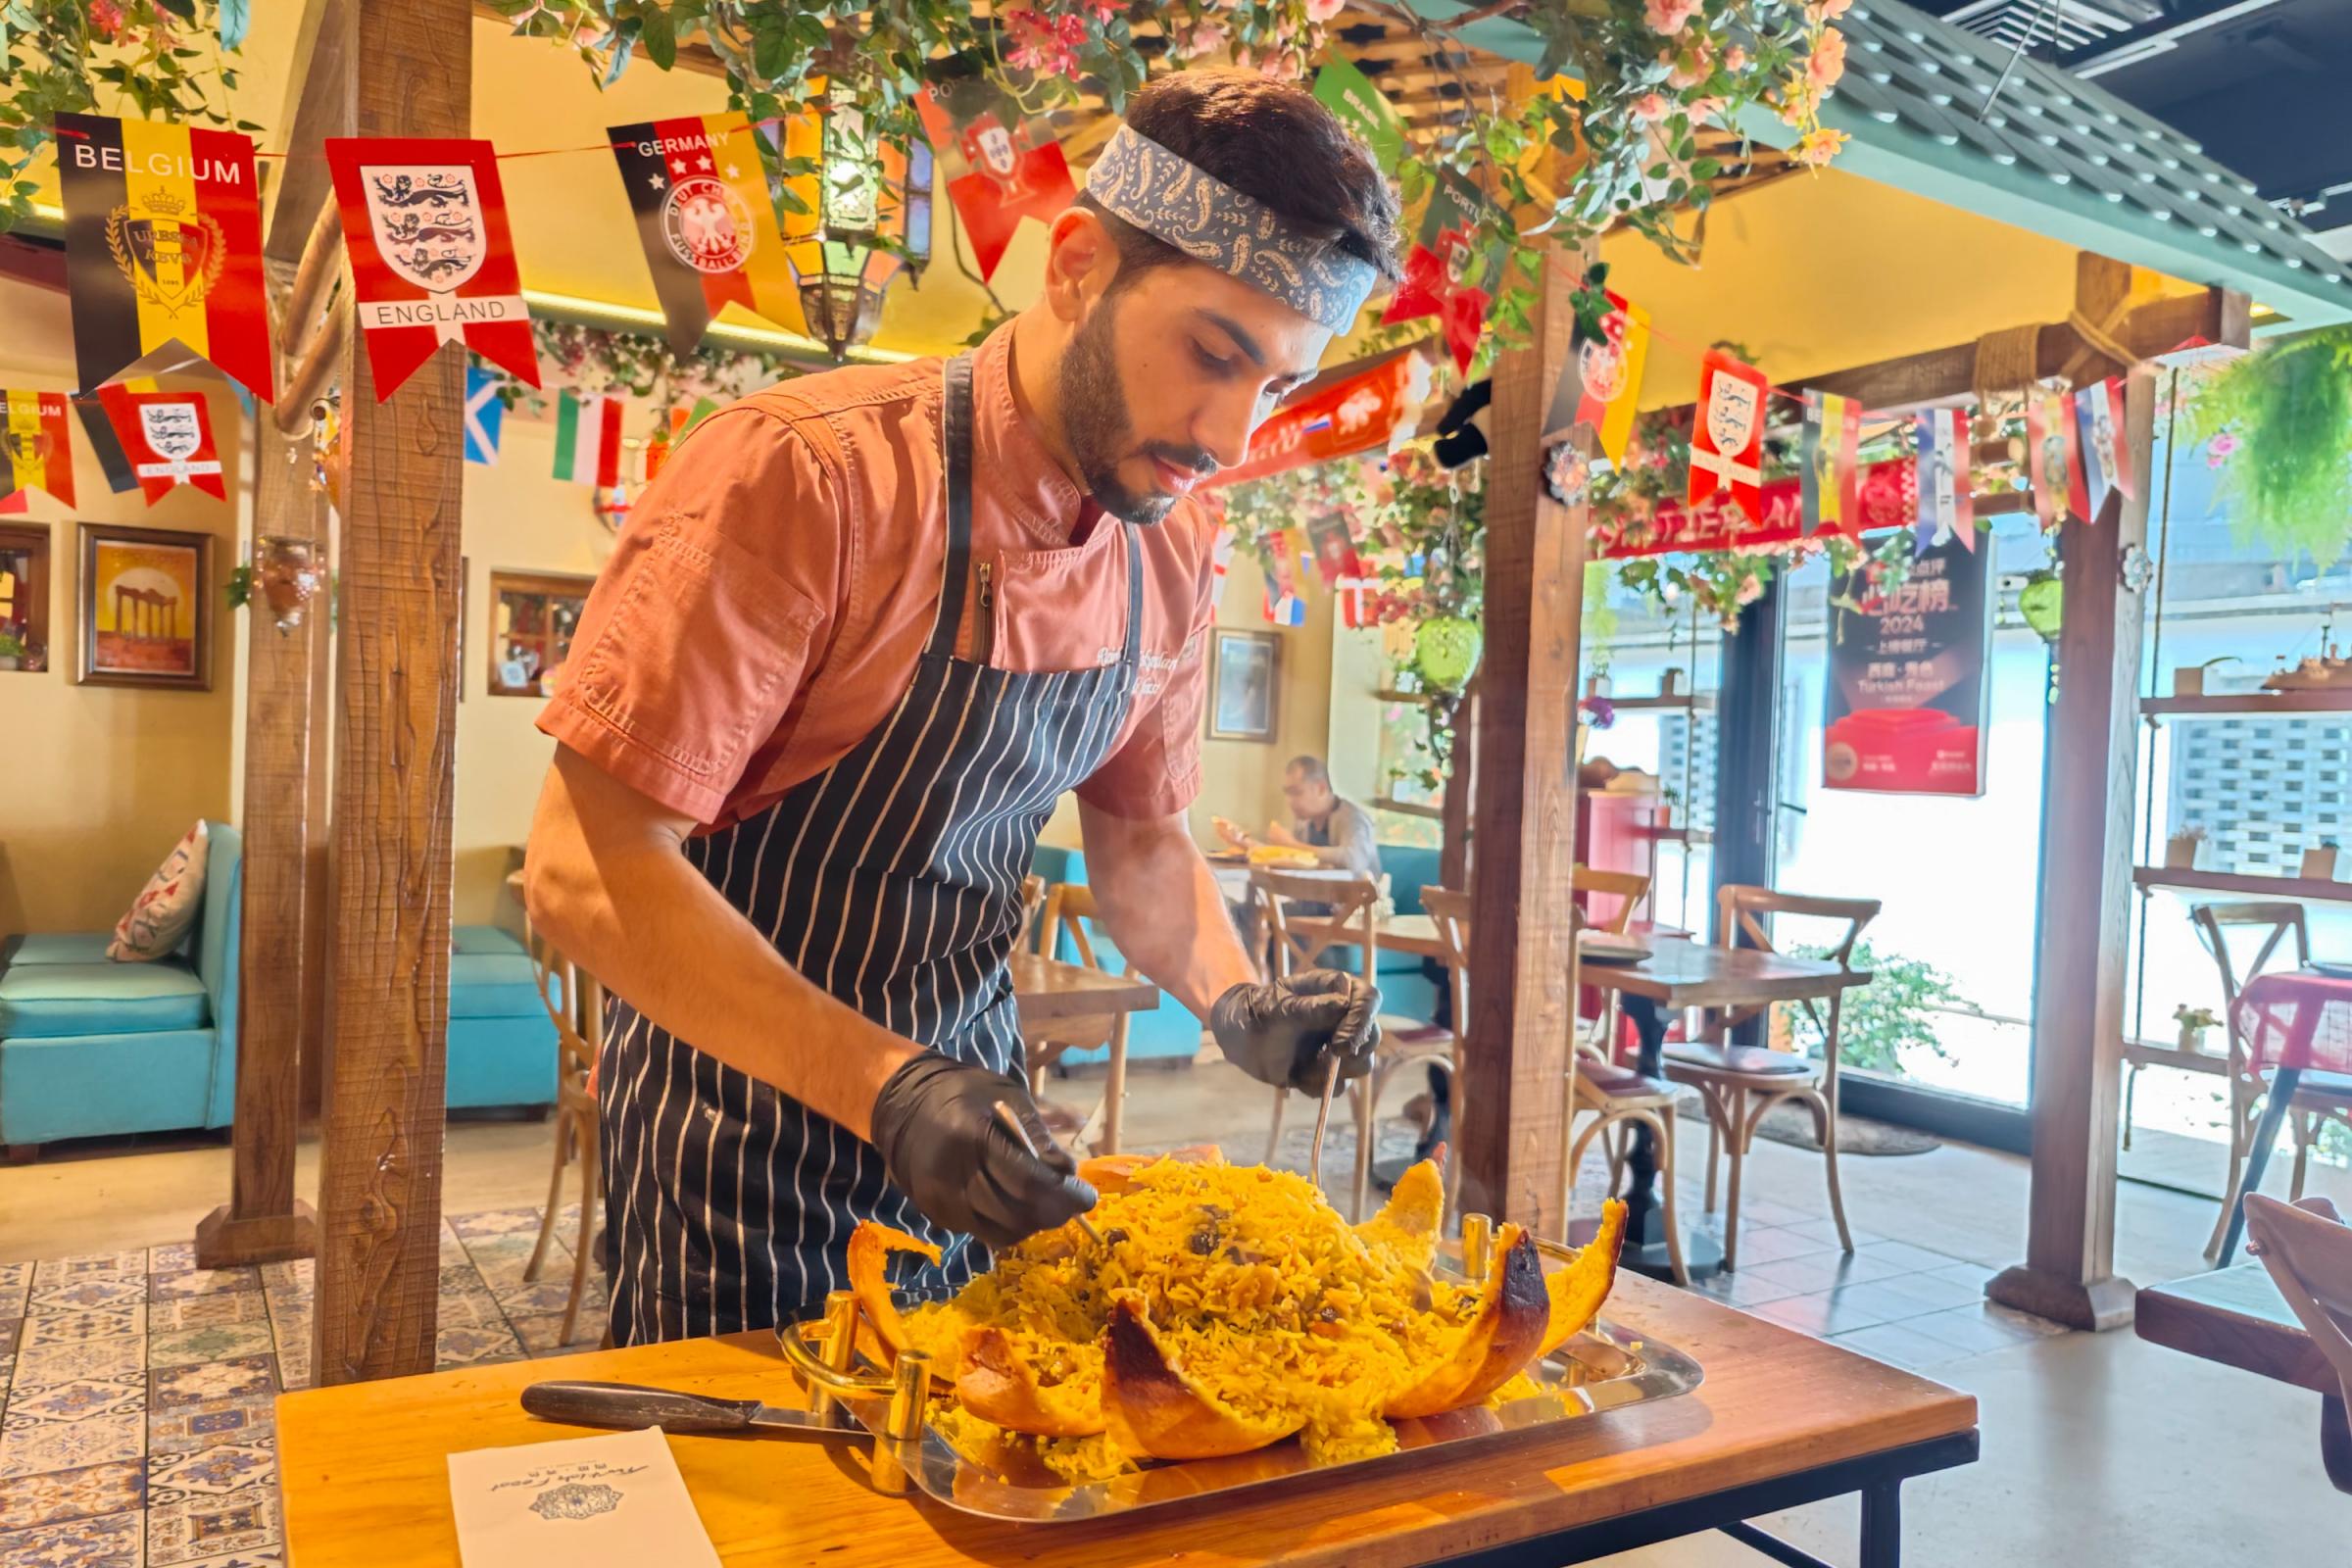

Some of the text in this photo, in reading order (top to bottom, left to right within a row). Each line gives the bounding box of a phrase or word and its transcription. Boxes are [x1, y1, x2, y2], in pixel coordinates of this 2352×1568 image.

[638, 131, 729, 158] GERMANY
[75, 144, 241, 185] BELGIUM
[377, 300, 507, 325] ENGLAND
[0, 402, 61, 416] ELGIUM
[147, 464, 210, 476] ENGLAND
[1880, 616, 1925, 636] 2024
